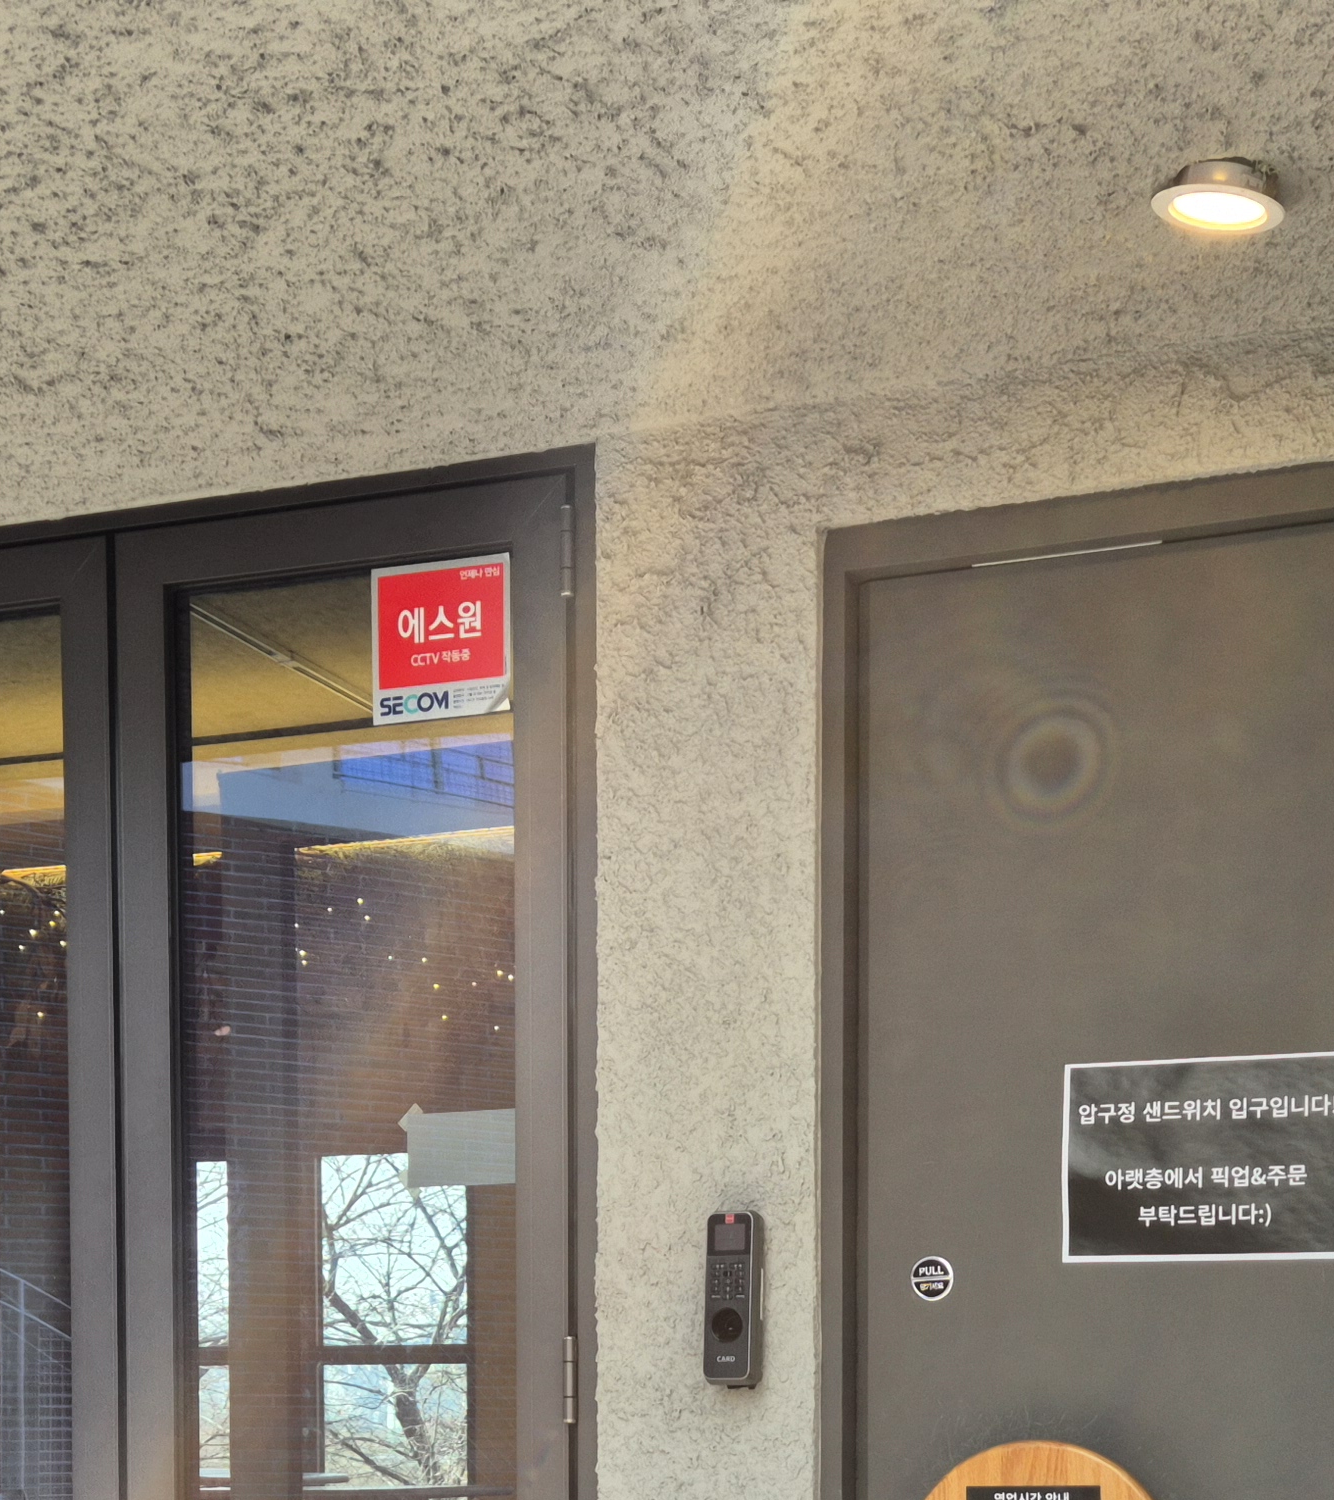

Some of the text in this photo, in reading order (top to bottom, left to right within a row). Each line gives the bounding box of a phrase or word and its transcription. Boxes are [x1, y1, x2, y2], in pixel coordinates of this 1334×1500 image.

[397, 600, 482, 644] 에스원
[411, 649, 470, 666] CCTV 작동중
[380, 690, 449, 717] SECOM
[1078, 1102, 1135, 1126] 압구정
[1143, 1099, 1221, 1122] 샌드위치
[1105, 1164, 1308, 1191] 아랫층에서 픽업&주문
[1138, 1203, 1272, 1227] 부탁드립니다:)
[919, 1266, 944, 1276] PULL
[717, 1355, 735, 1363] CARD
